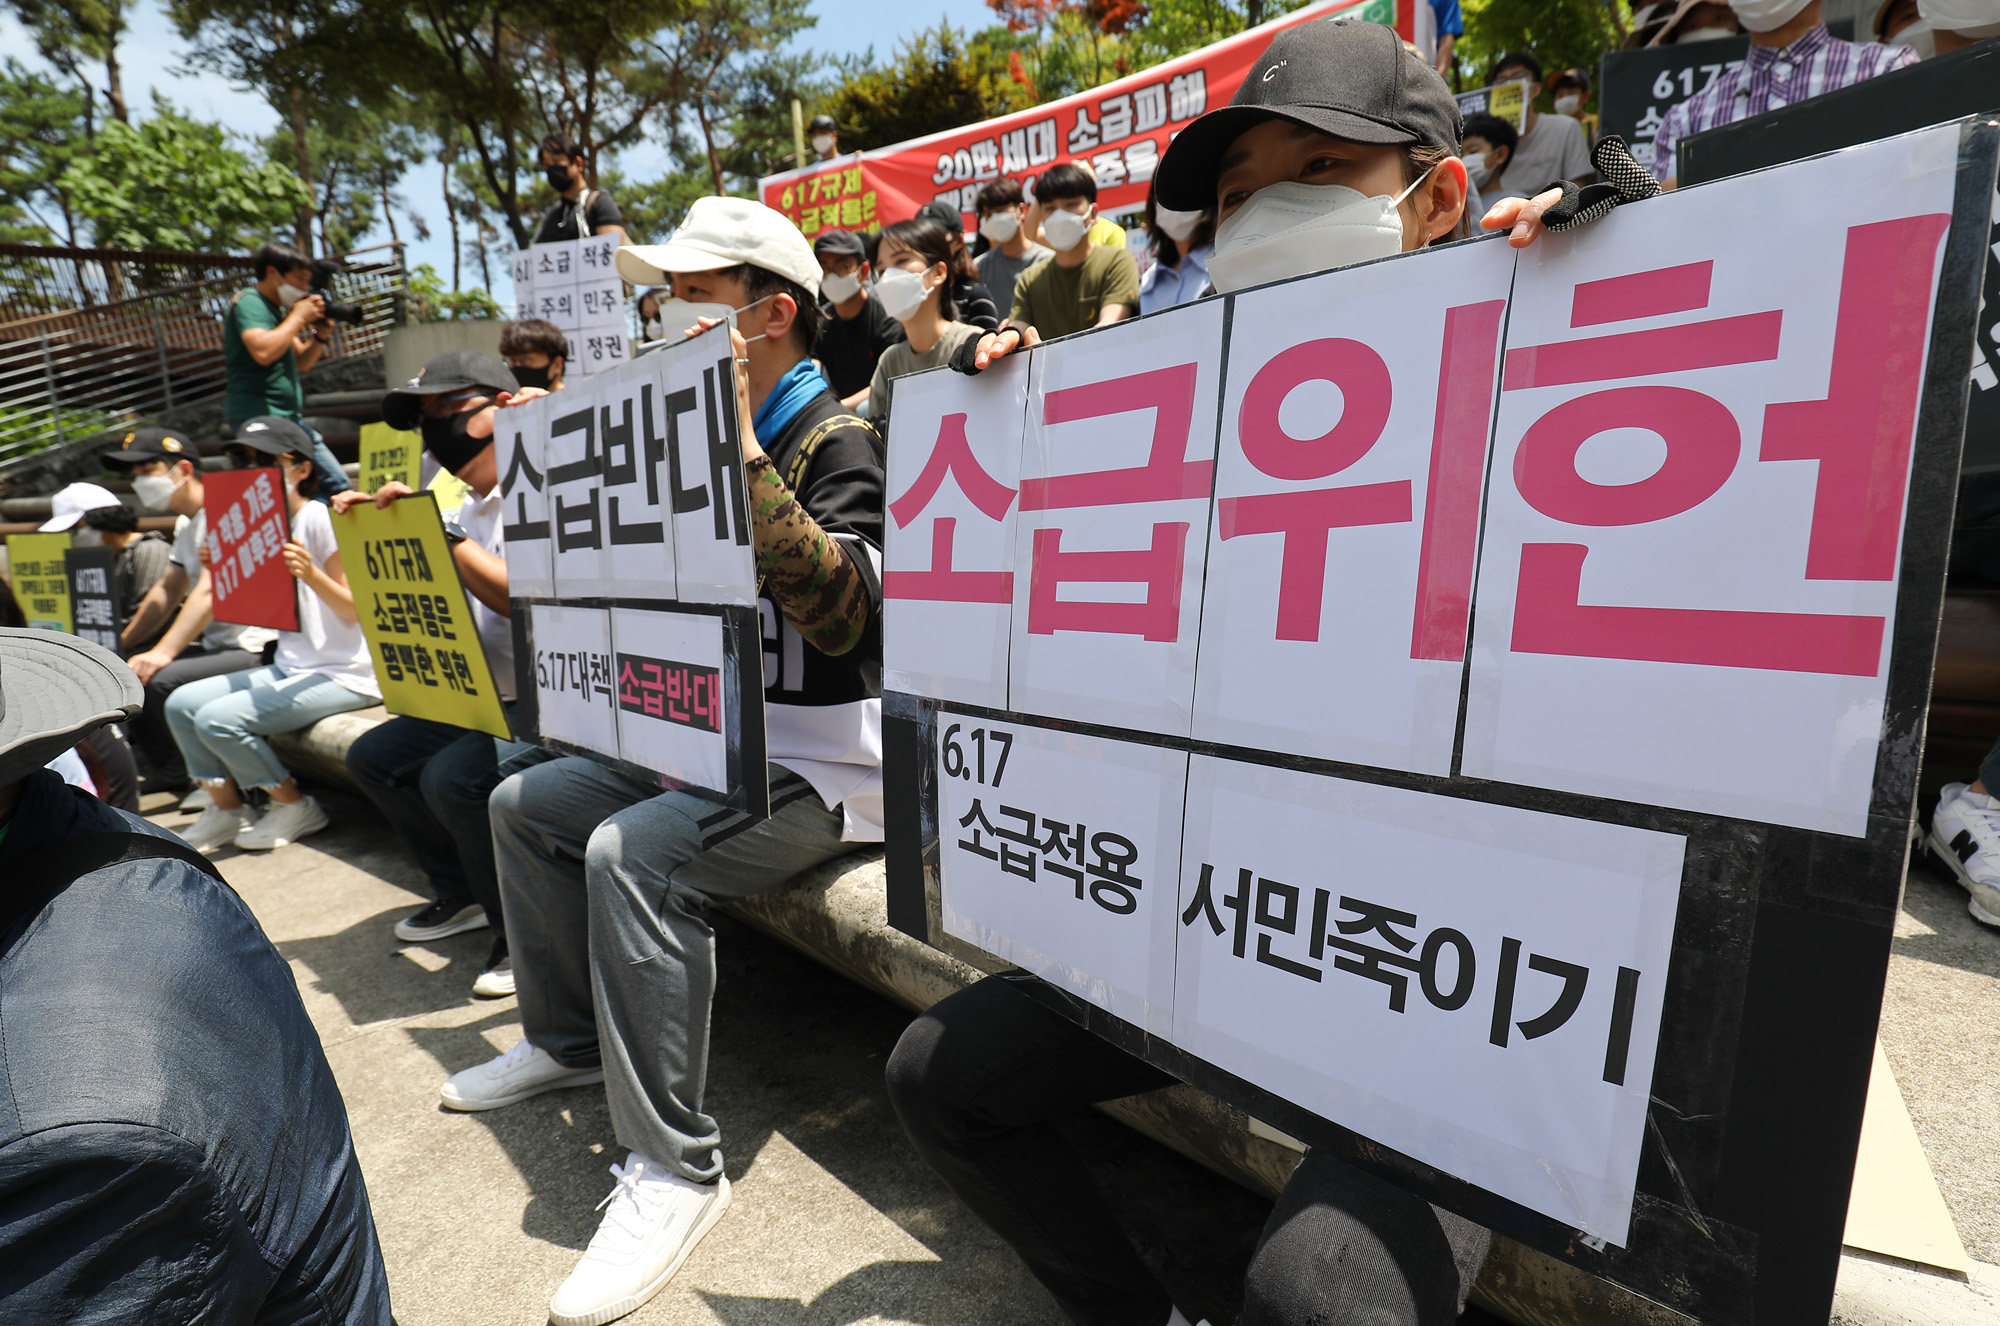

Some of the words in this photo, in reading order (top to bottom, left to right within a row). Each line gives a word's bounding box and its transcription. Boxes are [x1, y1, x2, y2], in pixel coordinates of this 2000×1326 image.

[932, 118, 1057, 185] 30만세대
[1067, 69, 1207, 154] 소급피해
[781, 166, 862, 210] 617규제
[787, 190, 877, 235] 급적용은
[538, 251, 570, 274] 소급
[582, 242, 614, 268] 적용
[541, 293, 572, 319] 주의
[583, 289, 616, 315] 민주
[587, 334, 623, 361] 정권
[500, 356, 750, 554] 소급반대
[883, 214, 1951, 678] 소급위헌
[214, 556, 239, 601] 617
[364, 538, 434, 582] 617규제
[373, 592, 457, 640] 소급적용은
[379, 642, 439, 687] 명백한
[435, 649, 478, 696] 위헌
[537, 650, 613, 708] 6.17대책
[619, 661, 721, 731] 소급반대
[942, 723, 1013, 787] 6.17
[957, 798, 1142, 915] 소급적용
[1182, 862, 1641, 1087] 서민죽이기
